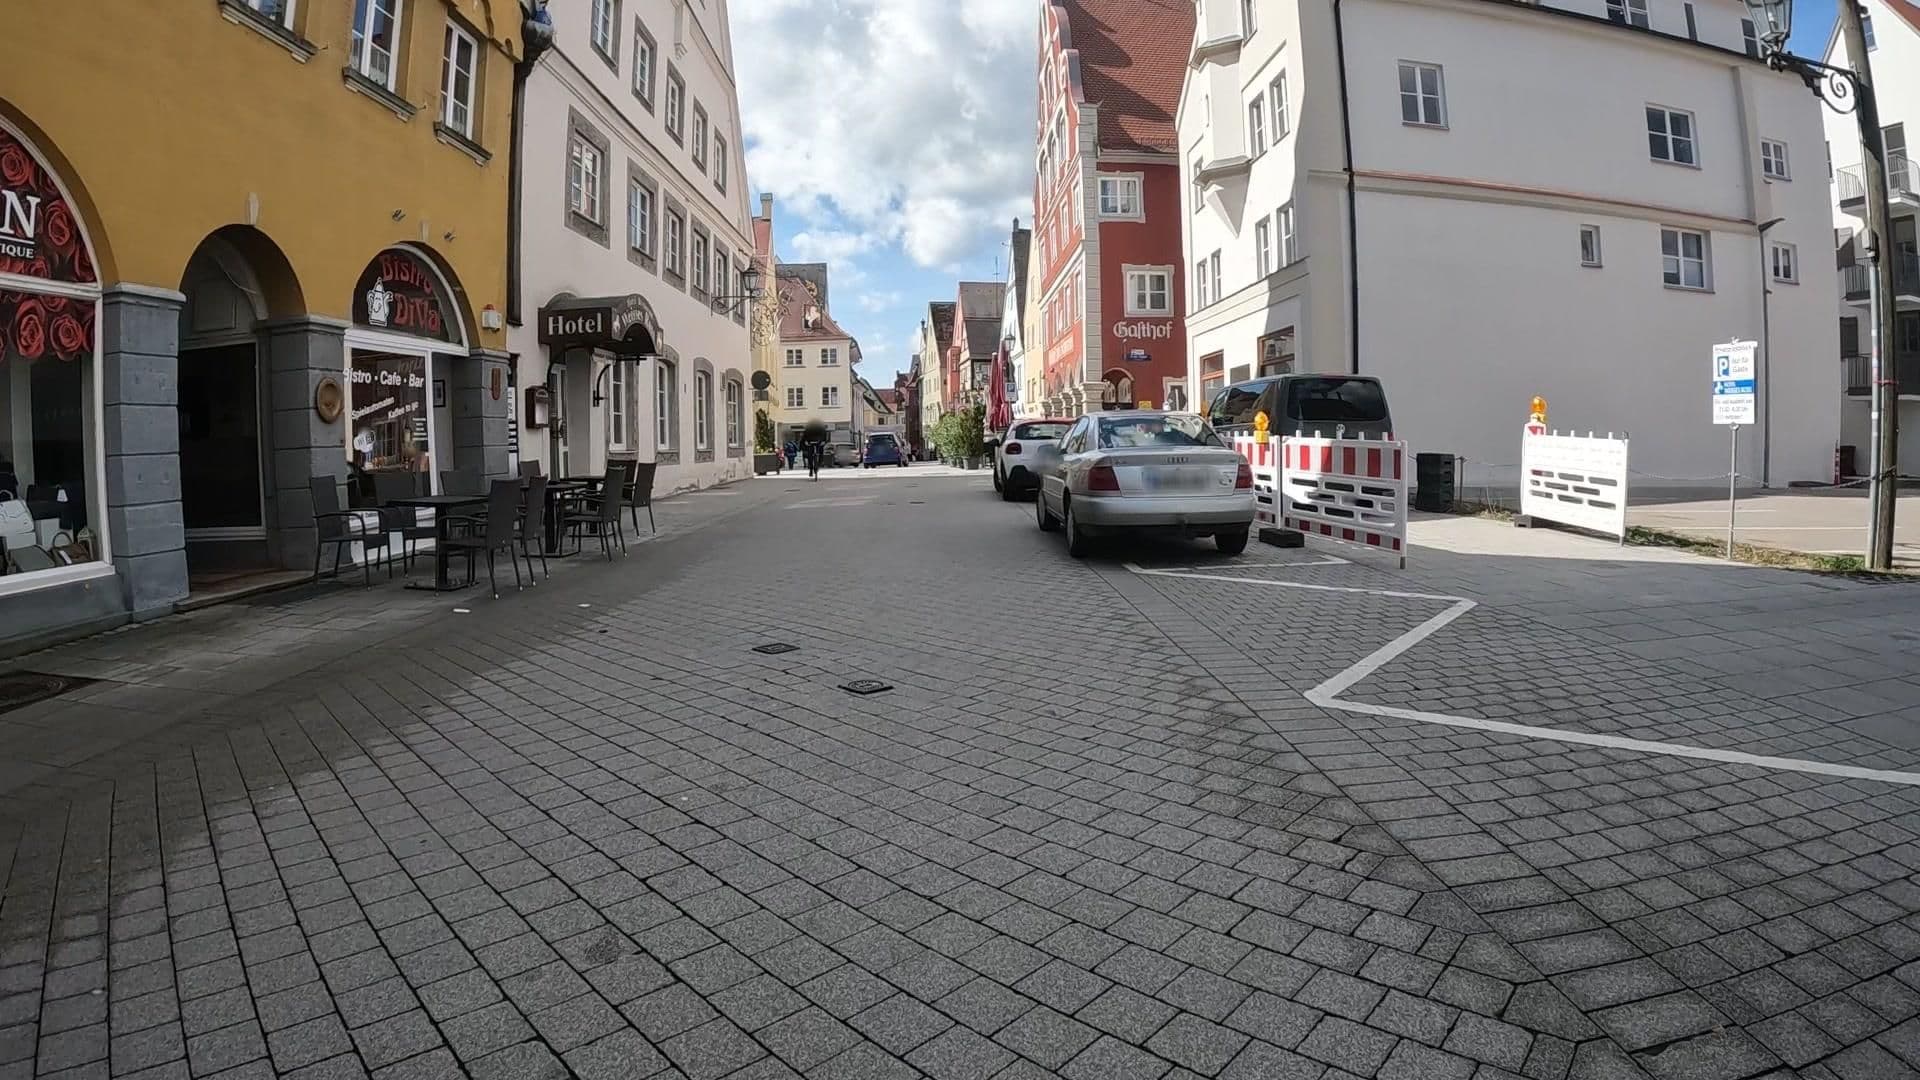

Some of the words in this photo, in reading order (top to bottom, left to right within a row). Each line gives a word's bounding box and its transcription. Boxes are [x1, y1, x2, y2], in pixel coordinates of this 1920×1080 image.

[548, 312, 603, 336] Hotel
[343, 367, 372, 384] Bistro
[380, 370, 401, 386] Cafe
[408, 373, 424, 388] Bar
